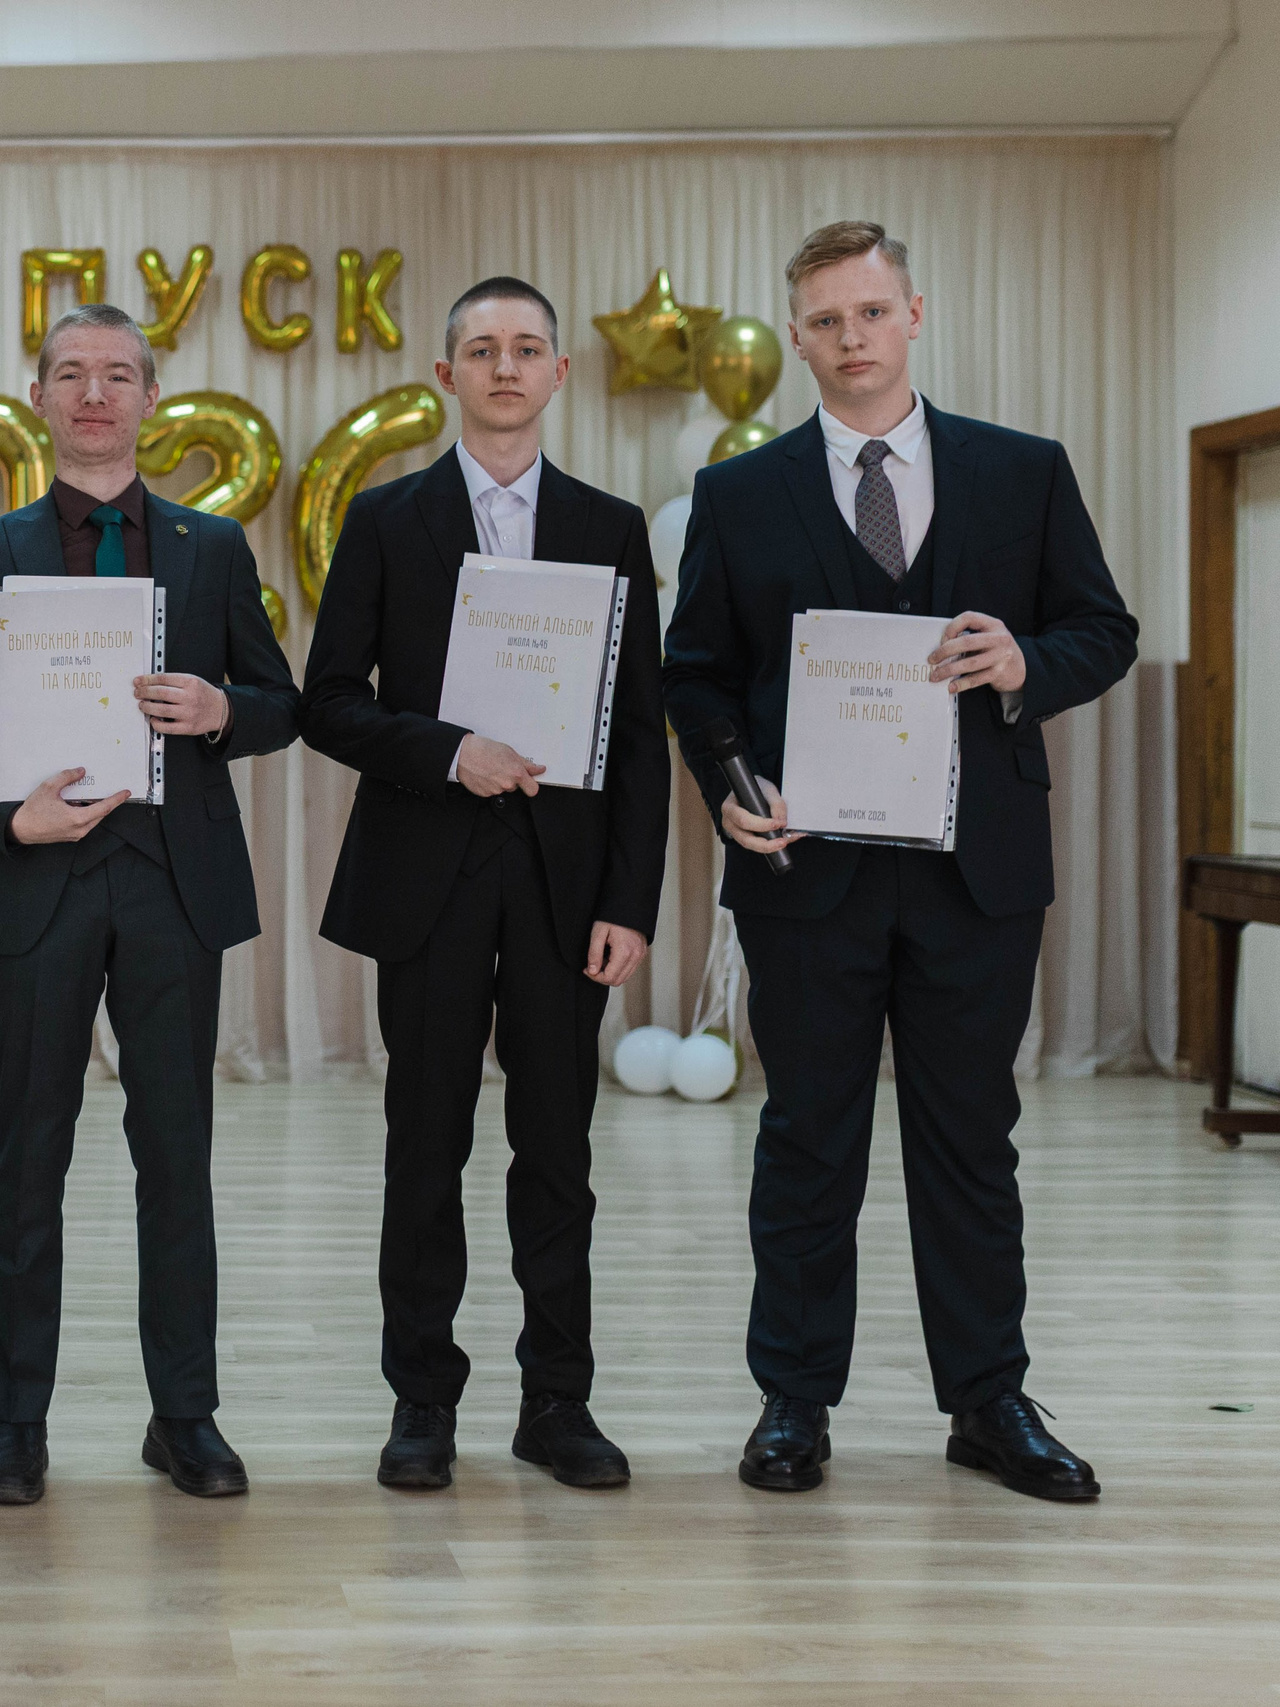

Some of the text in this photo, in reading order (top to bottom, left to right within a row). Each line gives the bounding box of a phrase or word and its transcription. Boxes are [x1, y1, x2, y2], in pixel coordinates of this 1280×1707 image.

[467, 609, 594, 637] ВЫПУСКНОЙ АЛЬБОМ
[8, 630, 133, 651] ВЫПУСКНОЙ АЛЬБОМ
[507, 636, 530, 648] ШКОЛА
[51, 656, 73, 666] ШКОЛА
[517, 654, 557, 674] КЛАСС
[806, 659, 882, 680] ВЫПУСКНОЙ
[63, 671, 102, 690] КЛАСС
[850, 685, 873, 697] ШКОЛА
[862, 704, 903, 723] КЛАСС
[838, 808, 886, 822] ВЫПУСК 2026
